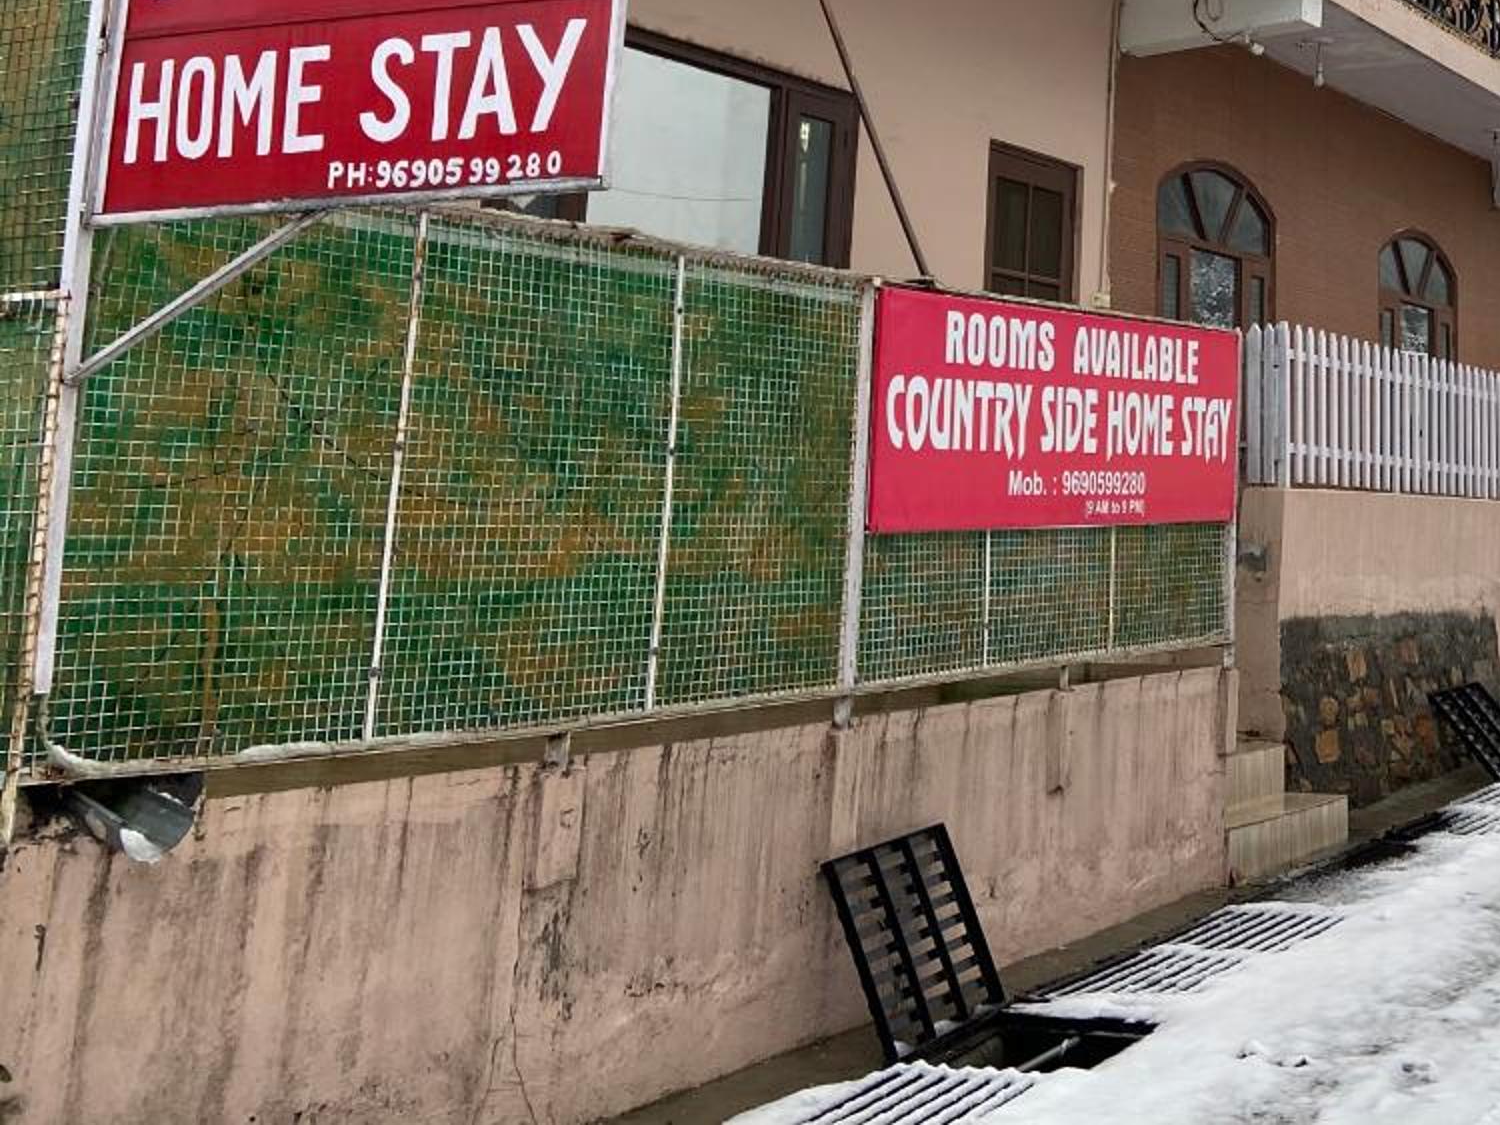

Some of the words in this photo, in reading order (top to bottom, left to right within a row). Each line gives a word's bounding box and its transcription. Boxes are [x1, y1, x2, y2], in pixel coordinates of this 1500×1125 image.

[123, 44, 331, 164] HOME
[359, 18, 587, 144] STAY
[945, 310, 1055, 372] ROOMS
[1073, 326, 1199, 384] AVAILABLE
[886, 375, 1033, 460] COUNTRY
[1040, 385, 1098, 454] SIDE
[1106, 390, 1174, 462] HOME
[1180, 395, 1233, 464] STAY
[1062, 471, 1145, 496] 9690599280
[1095, 499, 1109, 514] AM
[1111, 499, 1121, 514] to
